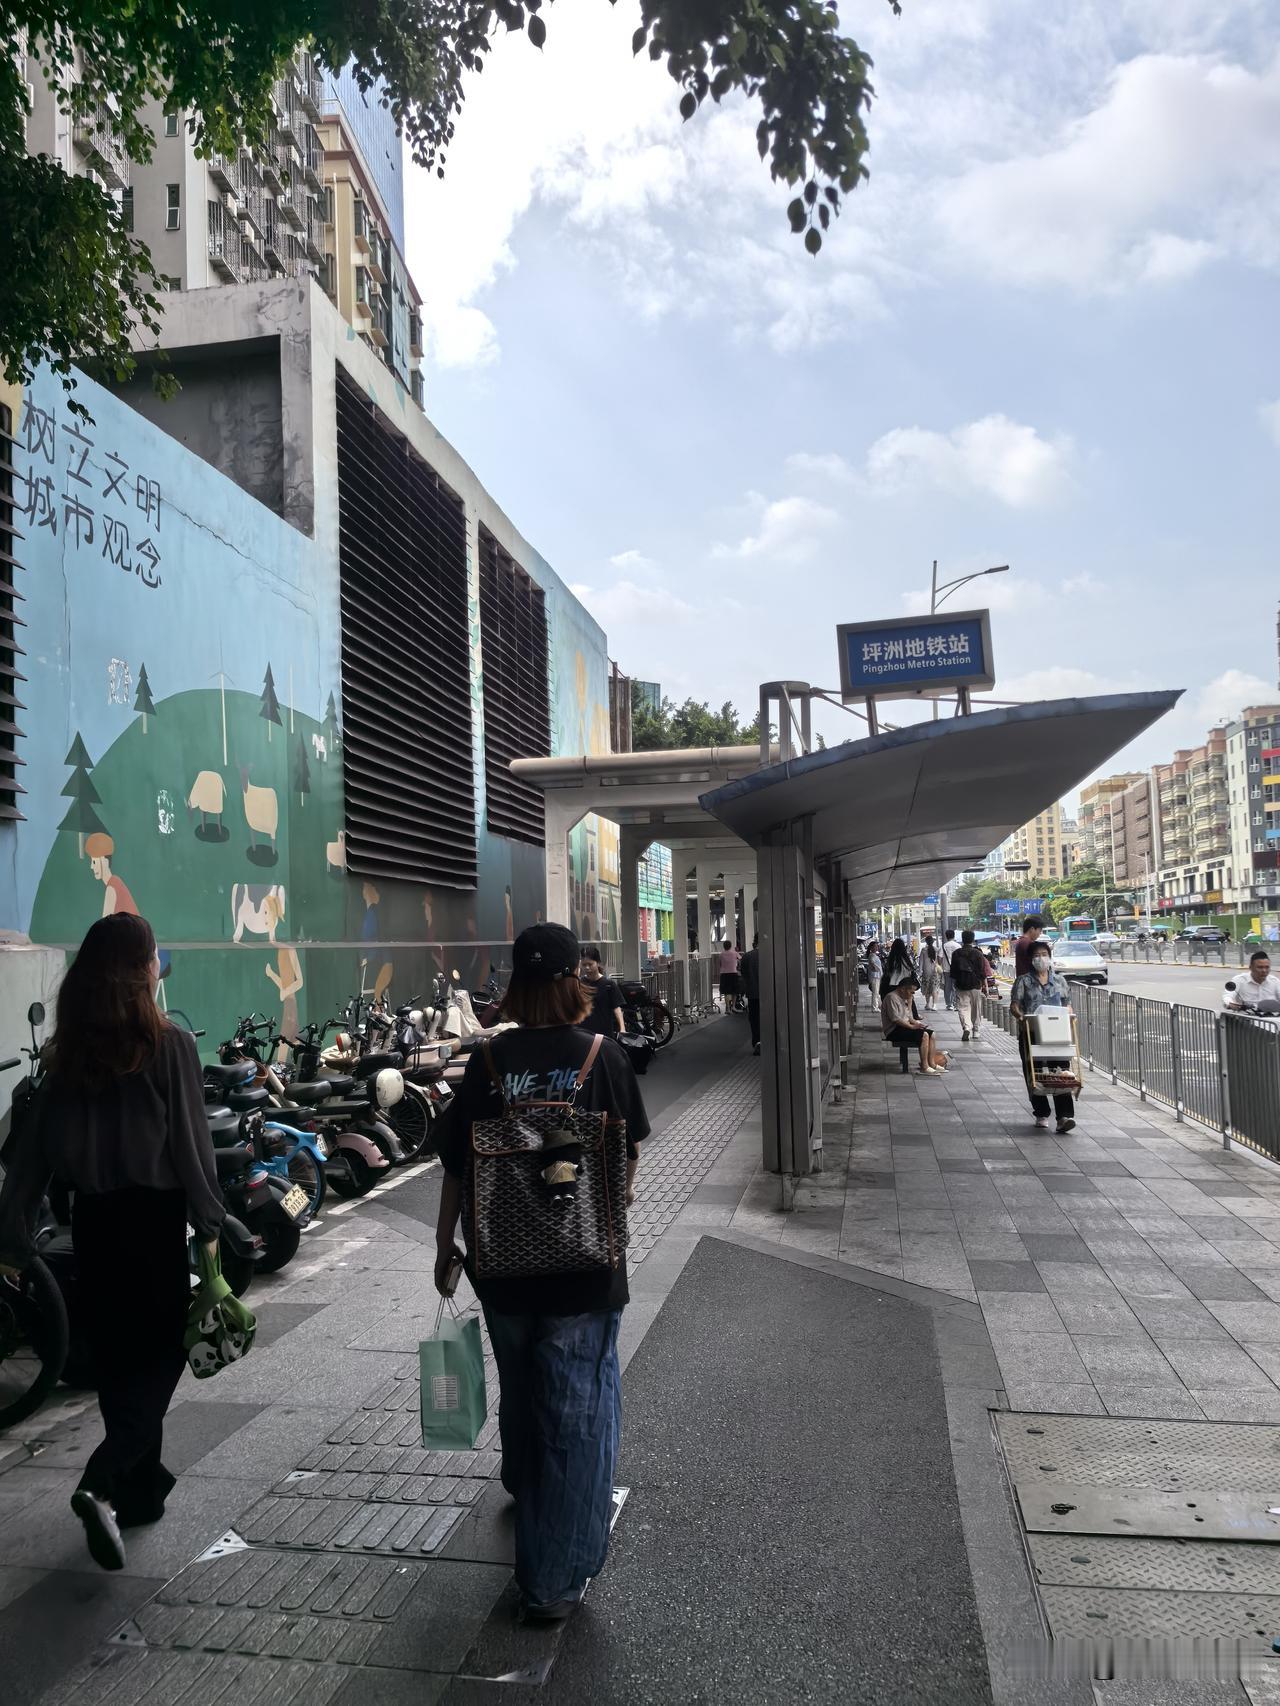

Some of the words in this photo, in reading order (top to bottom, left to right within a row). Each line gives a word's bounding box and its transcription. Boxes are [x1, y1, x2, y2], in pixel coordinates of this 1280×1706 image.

[23, 390, 160, 532] 树立文明
[24, 466, 161, 588] 城市观念
[862, 633, 969, 662] 坪洲地铁站
[862, 661, 906, 675] Pingzhou
[907, 659, 936, 670] Metro
[938, 655, 971, 666] Station
